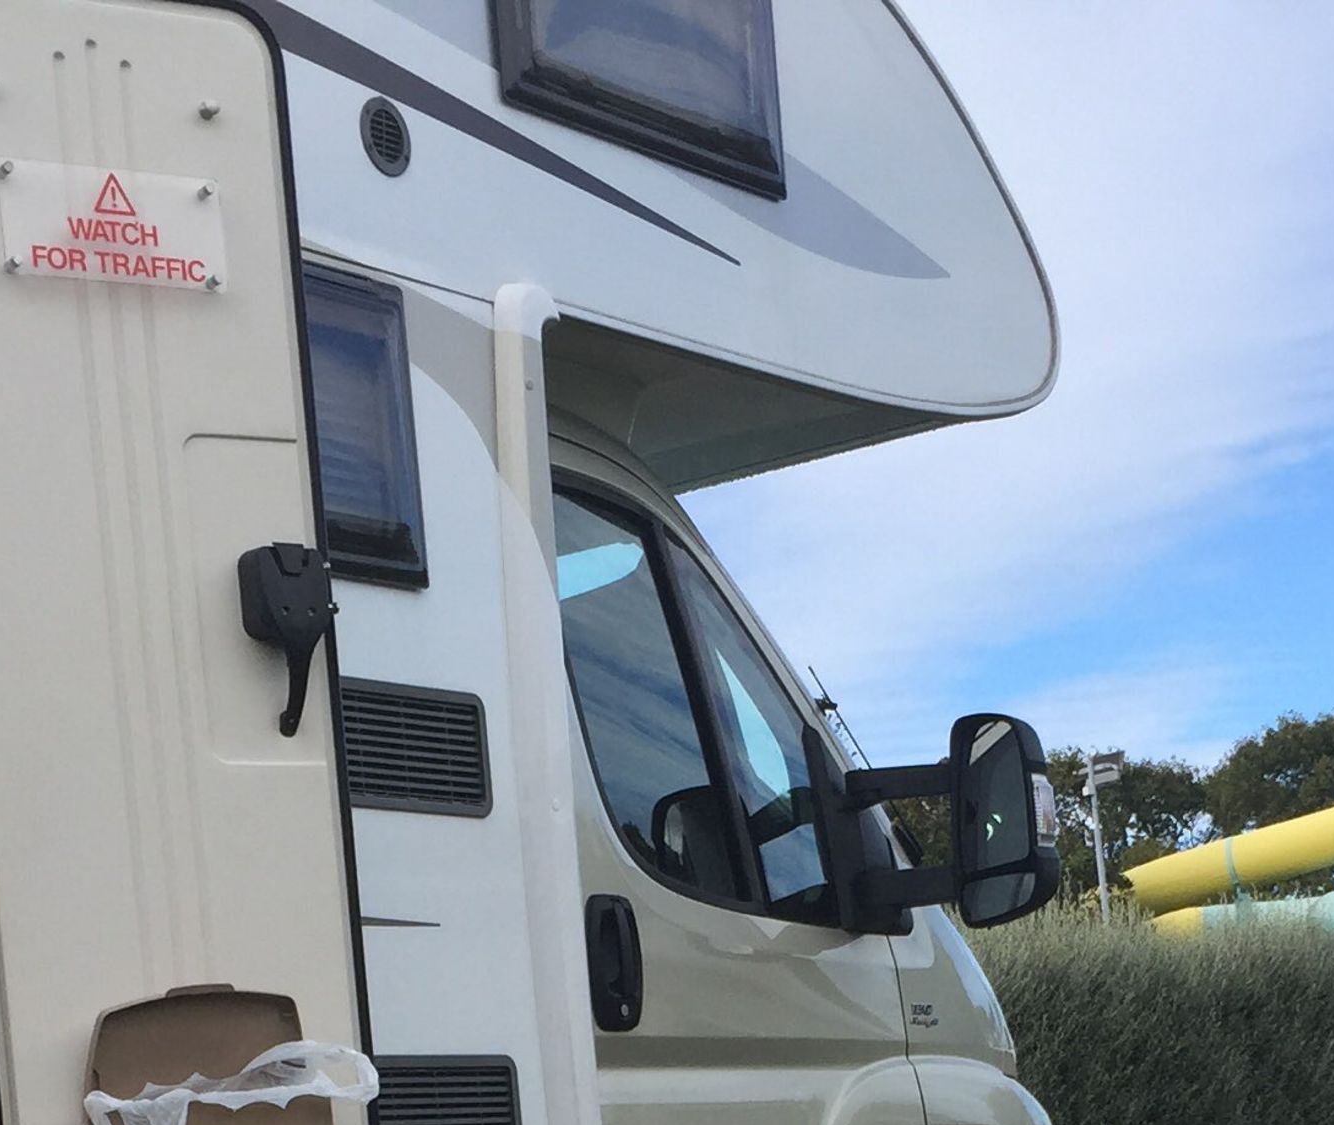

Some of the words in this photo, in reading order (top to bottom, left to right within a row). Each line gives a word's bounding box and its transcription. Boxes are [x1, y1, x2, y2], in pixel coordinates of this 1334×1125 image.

[67, 216, 159, 247] WATCH
[31, 245, 87, 272] FOR
[94, 251, 206, 283] TRAFFIC
